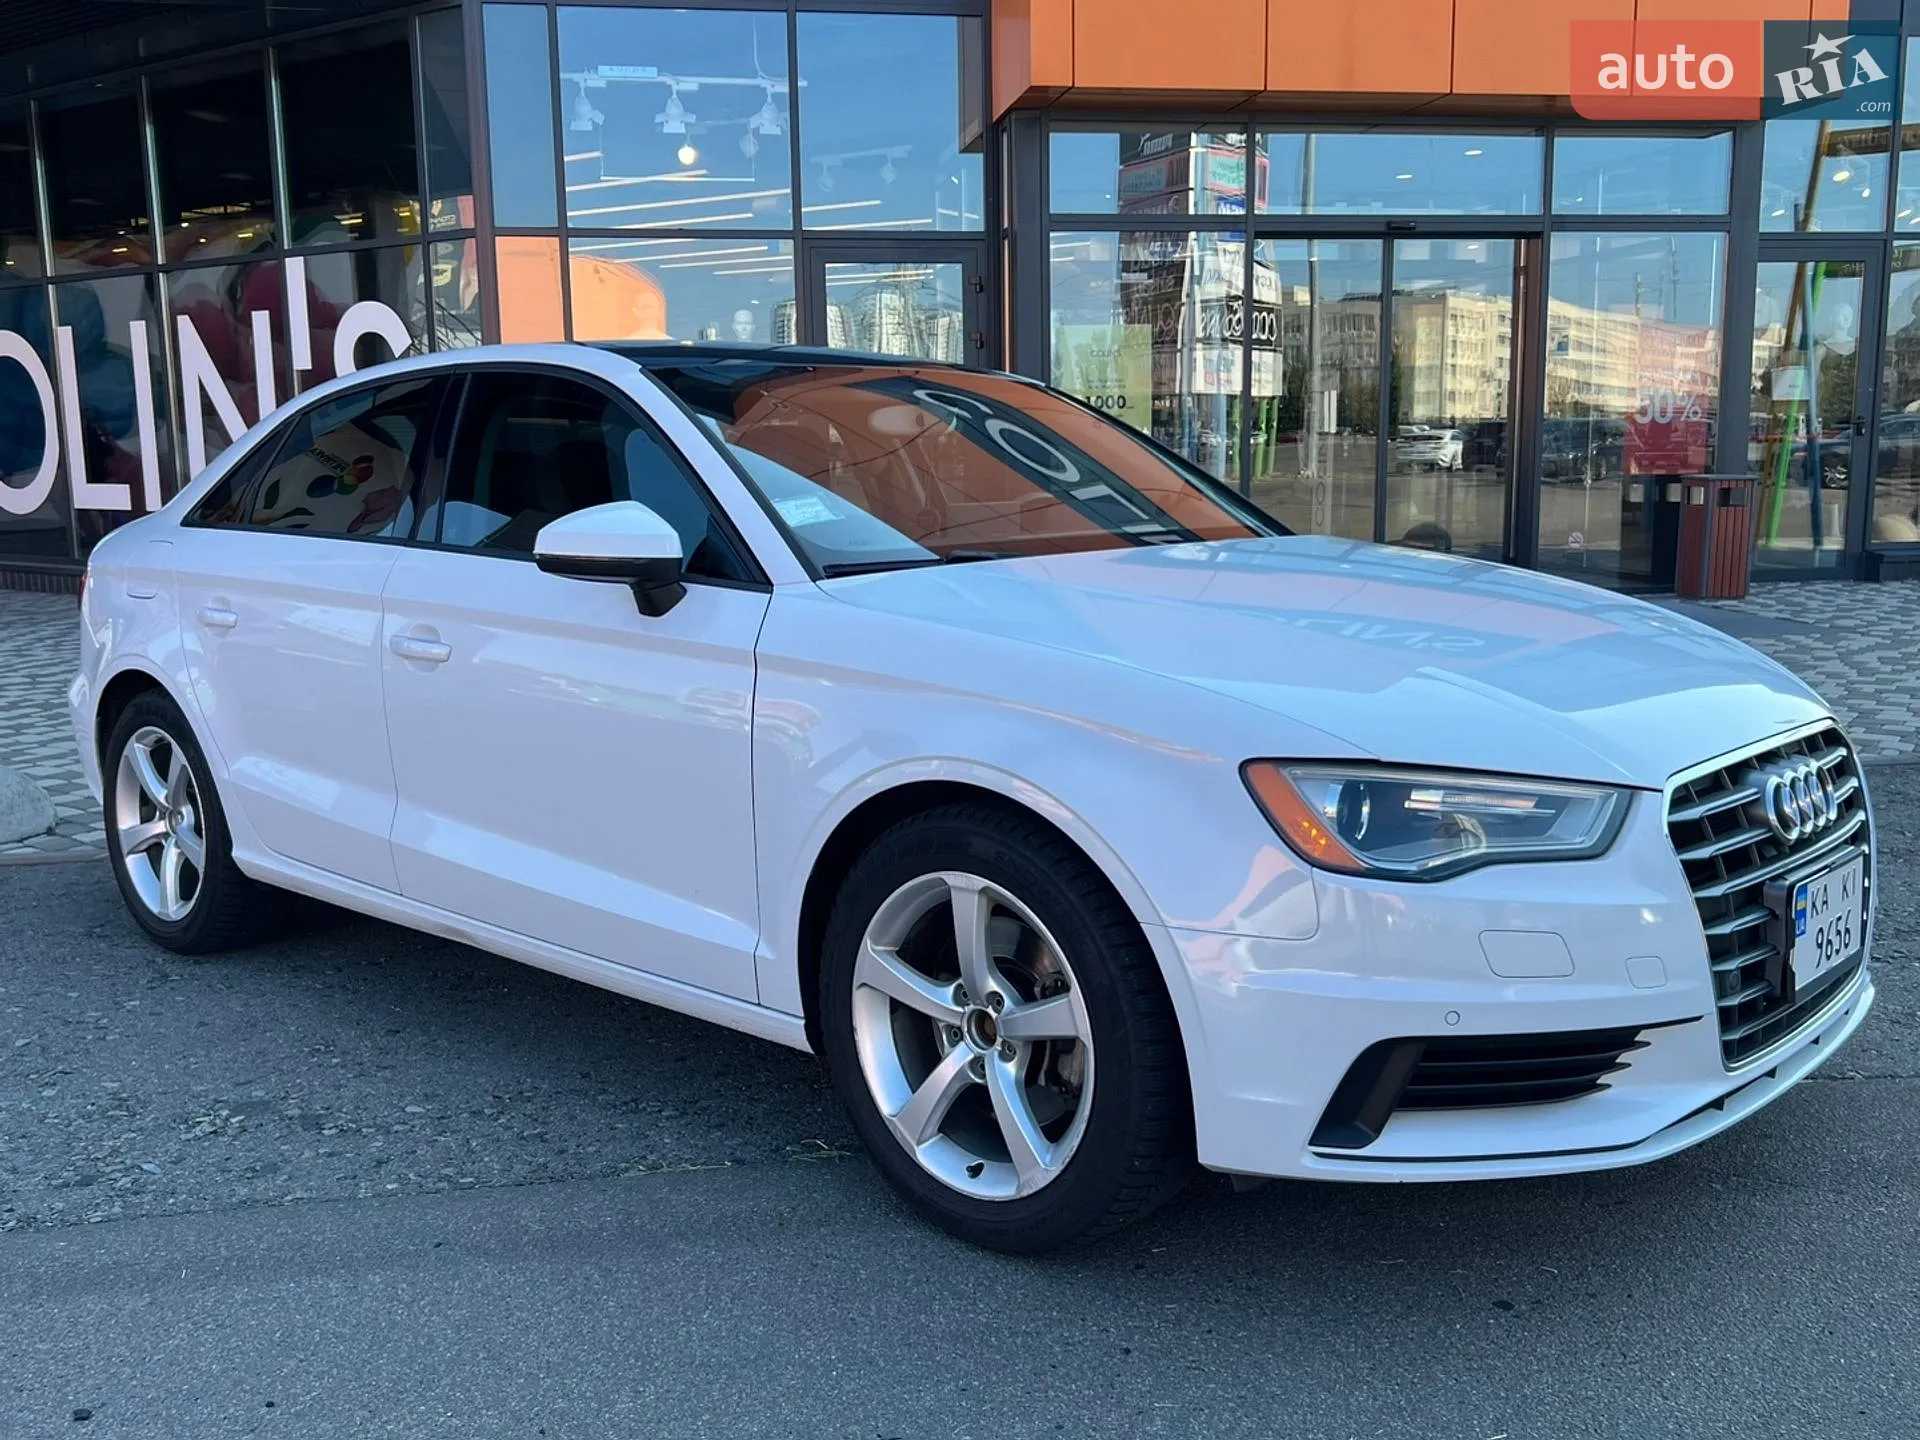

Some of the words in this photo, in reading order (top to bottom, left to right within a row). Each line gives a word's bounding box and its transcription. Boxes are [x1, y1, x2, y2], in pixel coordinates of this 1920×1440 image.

[1810, 884, 1829, 919] KA
[1841, 868, 1856, 902] KI
[1816, 908, 1851, 969] 9656
